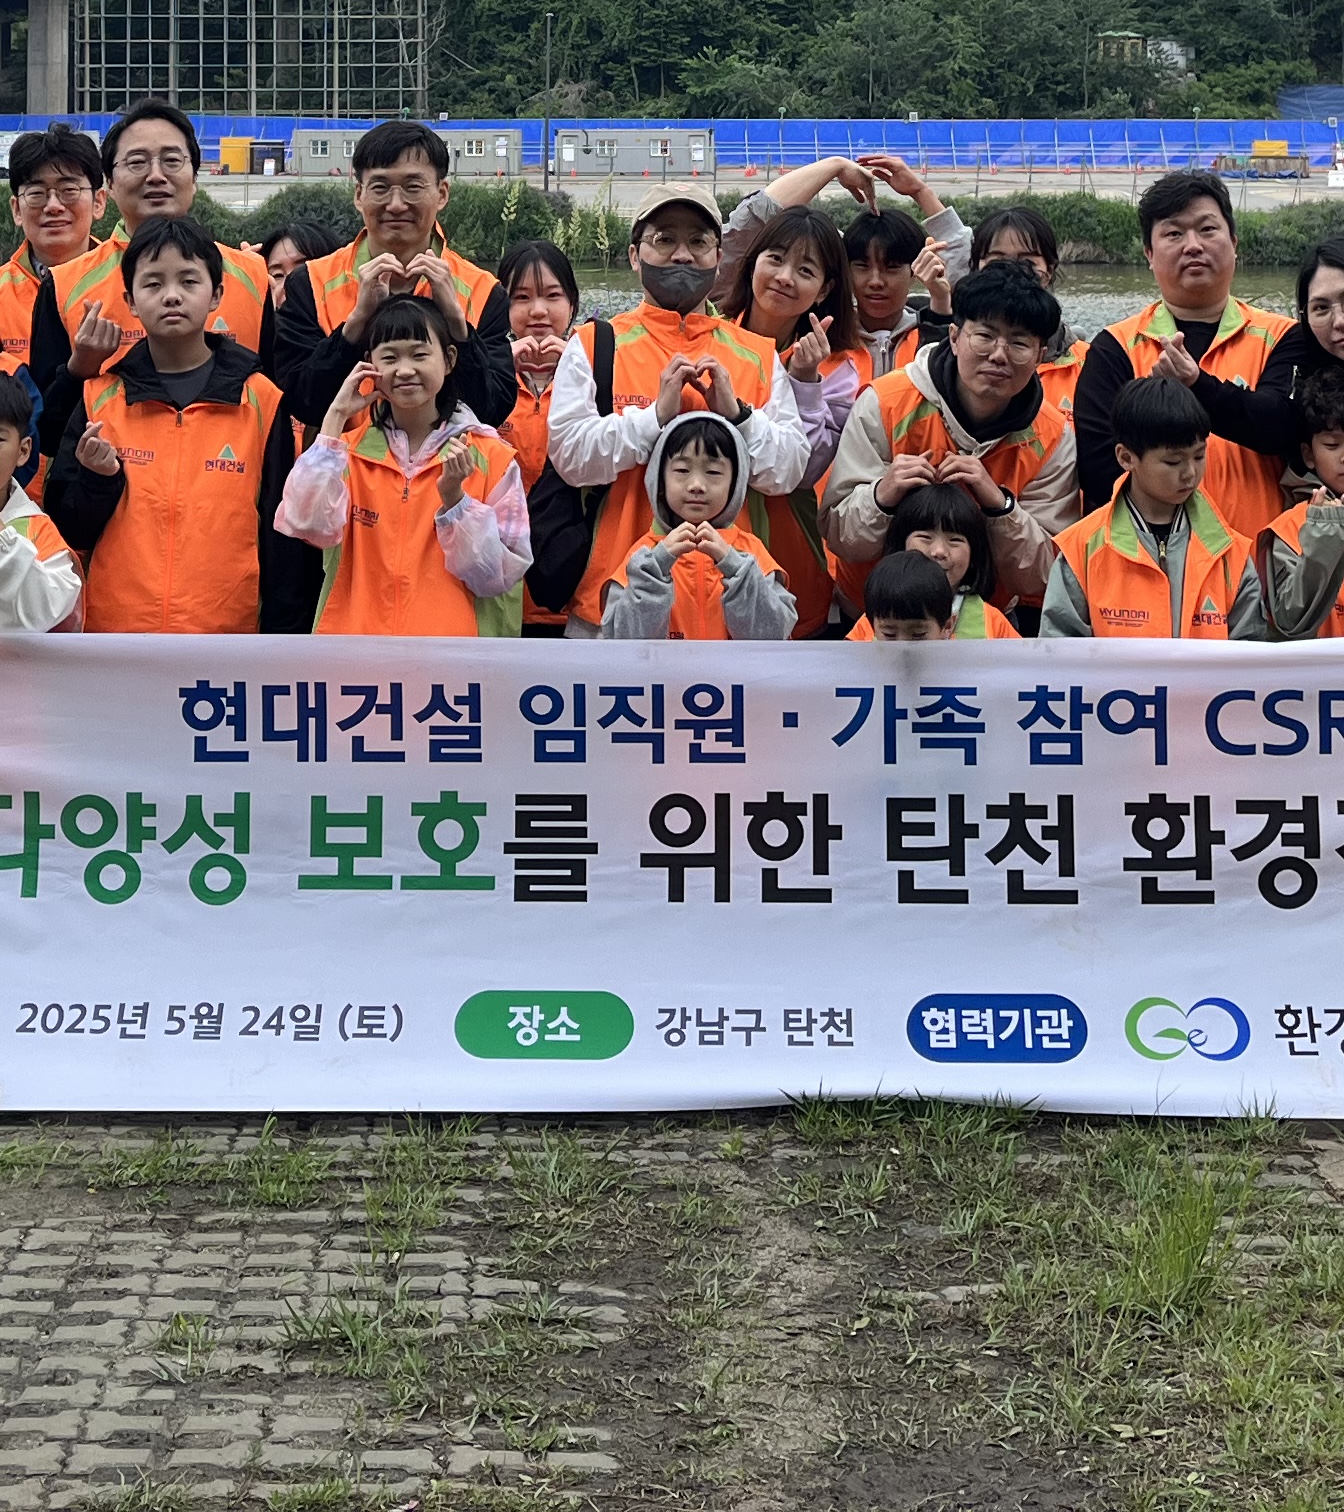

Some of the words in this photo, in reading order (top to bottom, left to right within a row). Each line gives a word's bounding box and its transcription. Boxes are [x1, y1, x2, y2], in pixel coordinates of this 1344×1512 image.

[1099, 608, 1150, 620] HYUNDAI
[178, 679, 484, 764] 현대건설
[518, 682, 748, 766] 임직원
[830, 683, 987, 767] 가족
[1016, 683, 1169, 766] 참여
[297, 789, 599, 904] 보호를
[639, 791, 844, 904] 위한
[885, 791, 1080, 906] 탄천
[16, 1001, 150, 1040] 2025년
[163, 1001, 225, 1041] 5월
[239, 1003, 323, 1042] 24일
[338, 1003, 404, 1044] (토)
[507, 1005, 581, 1047] 장소
[655, 1006, 767, 1048] 강남구
[783, 1006, 854, 1048] 탄천
[921, 1007, 1074, 1049] 협력기관
